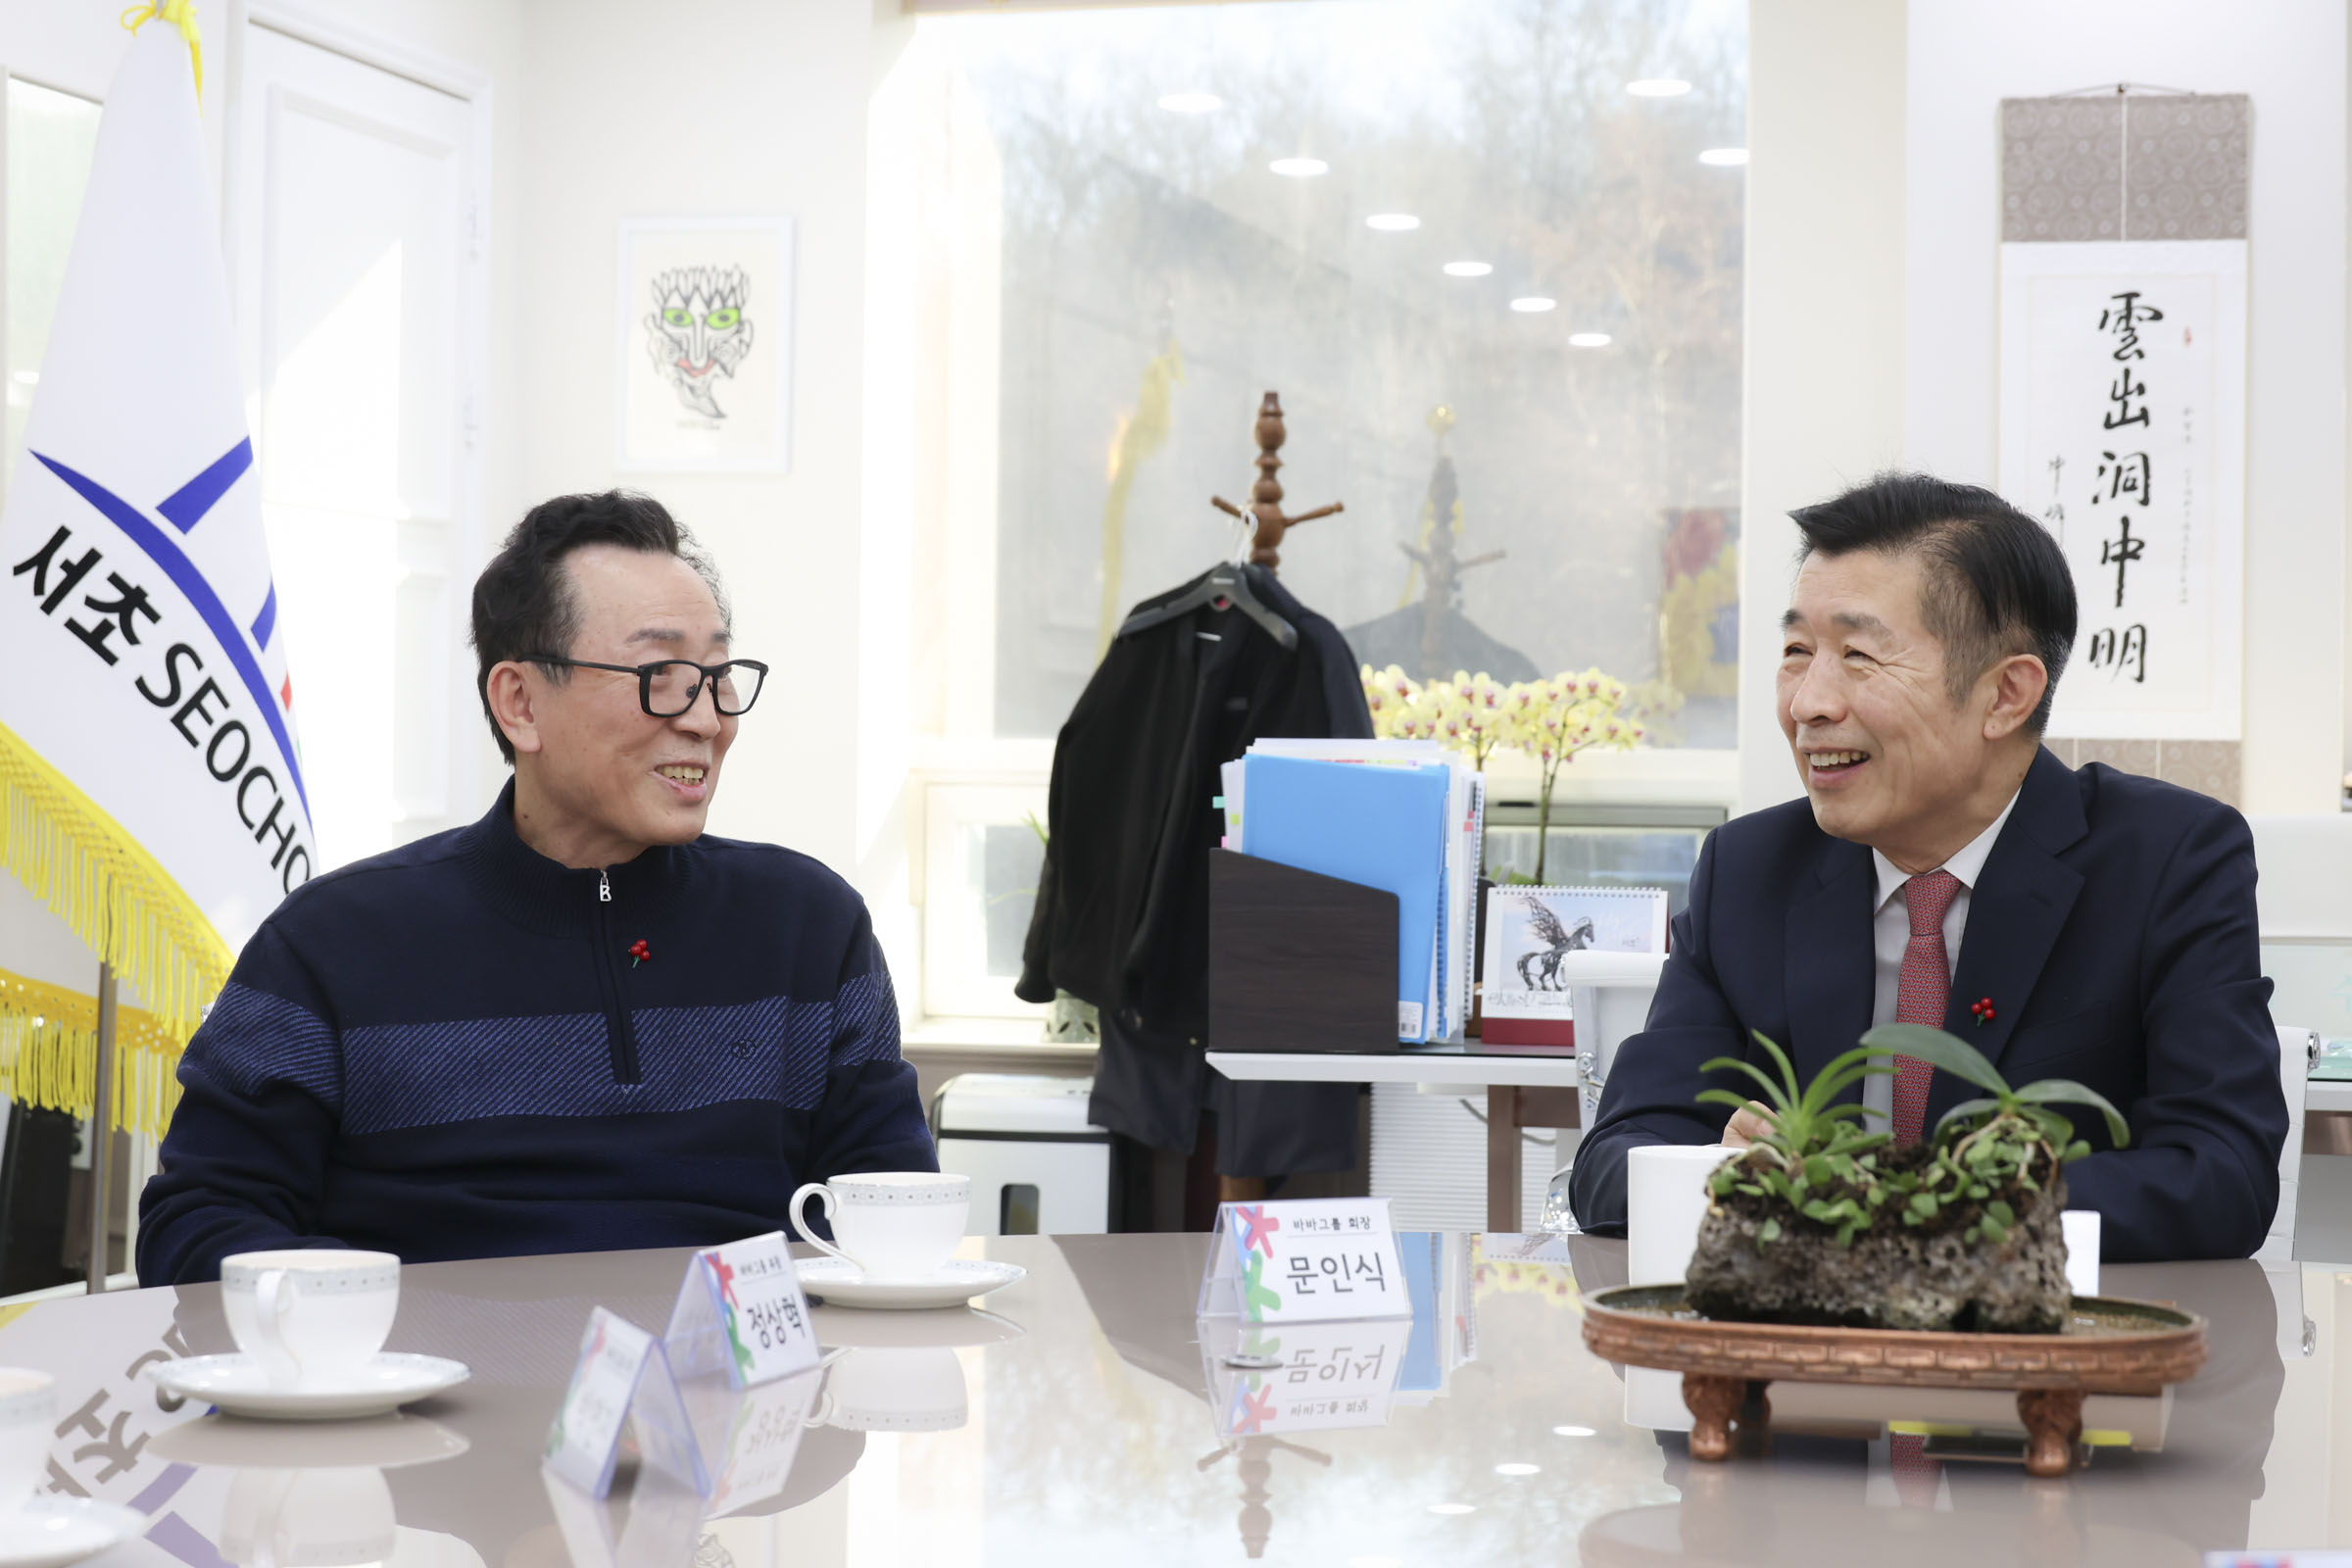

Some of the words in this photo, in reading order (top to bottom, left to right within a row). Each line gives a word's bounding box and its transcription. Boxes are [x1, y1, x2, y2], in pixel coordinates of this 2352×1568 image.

[2088, 291, 2164, 684] 雲出洞中明
[13, 525, 162, 666] 서초
[1348, 1214, 1371, 1231] 회장
[1286, 1250, 1387, 1295] 문인식
